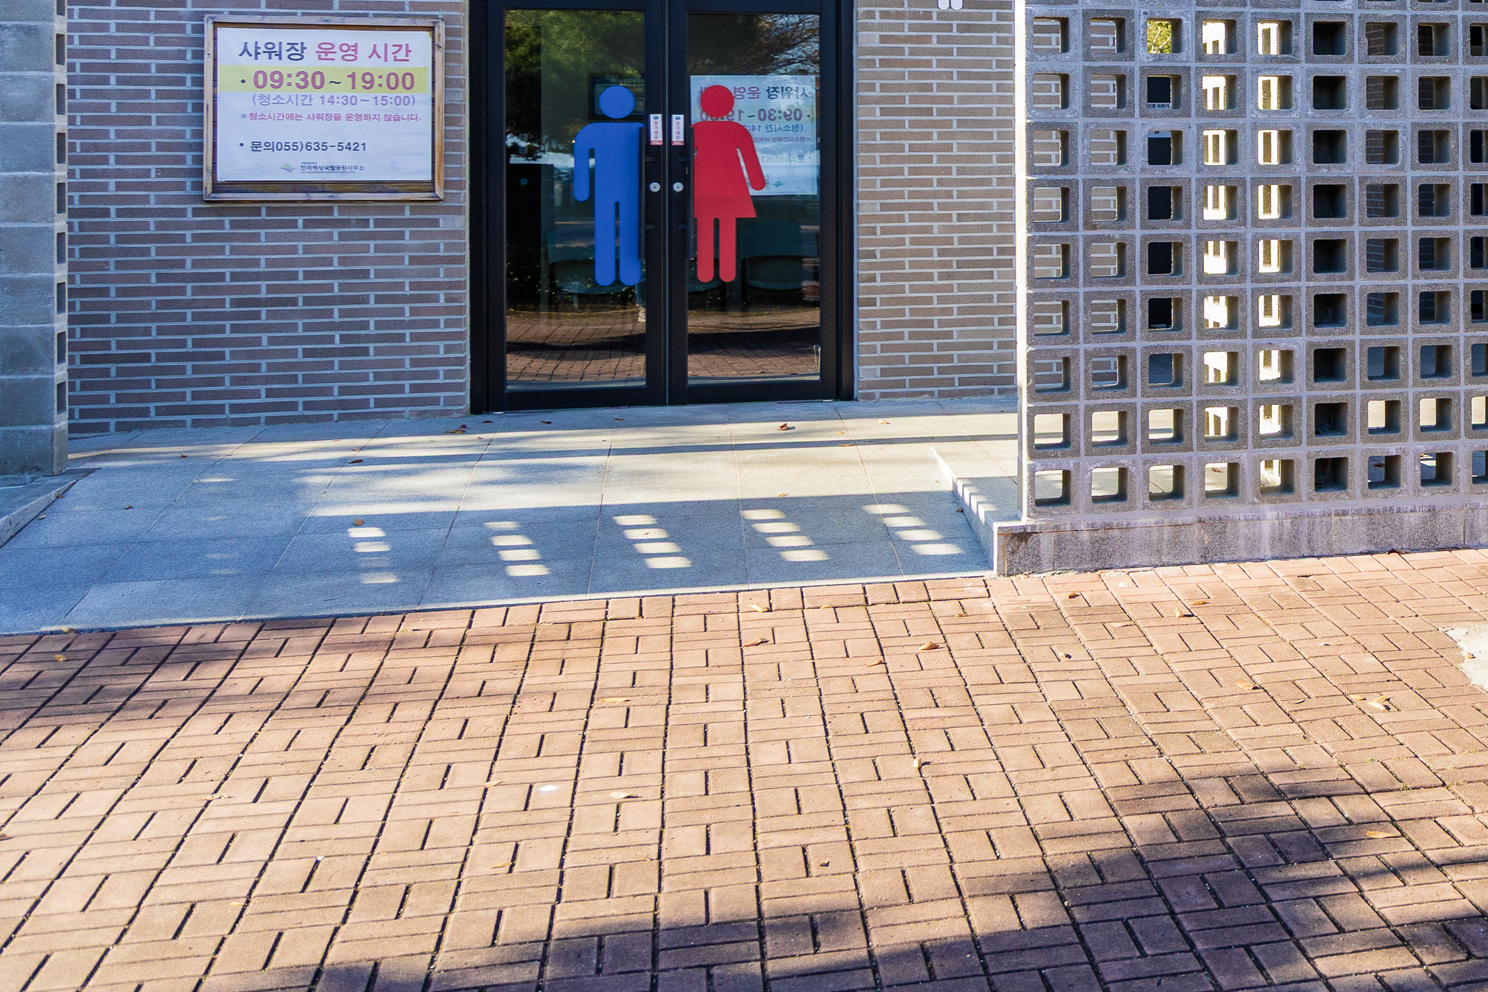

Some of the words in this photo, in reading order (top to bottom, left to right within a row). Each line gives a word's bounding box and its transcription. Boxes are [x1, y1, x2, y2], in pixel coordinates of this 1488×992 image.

[239, 41, 307, 61] 샤워장
[315, 42, 358, 62] 운영
[367, 43, 412, 62] 시간
[252, 93, 313, 107] (청소시간
[345, 113, 381, 122] 운영하지
